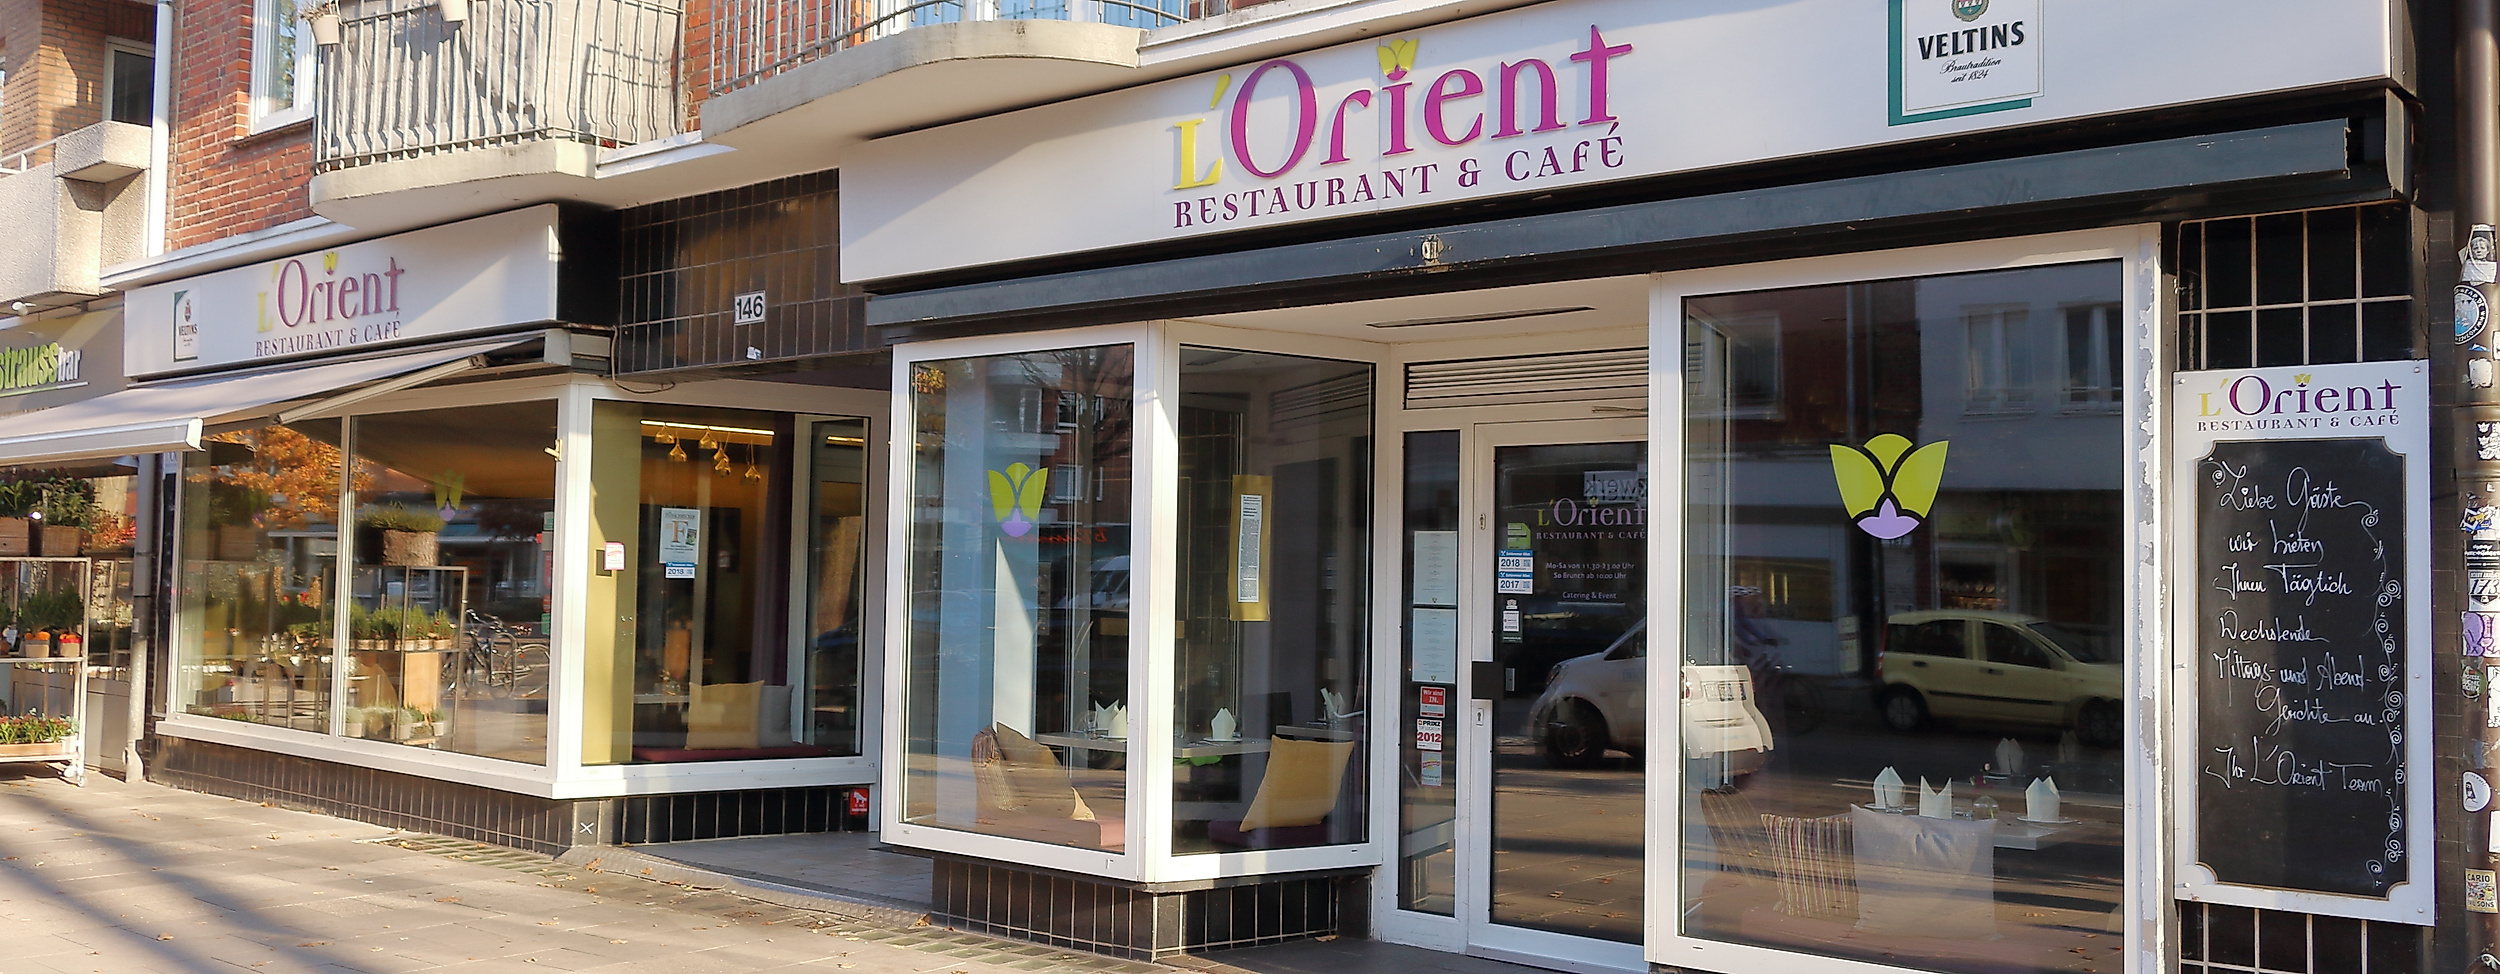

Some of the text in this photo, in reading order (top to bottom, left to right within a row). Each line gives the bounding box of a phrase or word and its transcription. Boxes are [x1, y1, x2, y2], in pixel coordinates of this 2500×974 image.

[1917, 20, 2025, 60] VELTINS
[1940, 57, 2001, 74] Brautradition
[1951, 69, 1989, 82] seit 1824
[1173, 24, 1634, 190] L'Orient
[1174, 122, 1624, 229] RESTAURANT & CAFÉ
[257, 256, 405, 332] L'Orient
[736, 295, 763, 320] 146
[255, 311, 401, 357] RESTAURANT & CAFÉ
[2198, 374, 2402, 416] L'Orient
[2197, 410, 2400, 432] RESTAURANT & CAFÉ
[1537, 497, 1646, 526] L'Orient
[2220, 461, 2347, 532] Liebe Gäste
[1537, 531, 1605, 540] RESTAURANT
[1618, 528, 1646, 539] CAFÉ
[2228, 520, 2324, 562] wir bieten
[1501, 558, 1520, 567] 2018
[1545, 562, 1567, 570] Mo-Sa
[1500, 580, 1519, 588] 2017
[1562, 591, 1590, 600] Catering
[2263, 563, 2352, 606] Täglich
[2255, 685, 2345, 736] Gerichte
[1417, 732, 1442, 742] 2012
[2328, 762, 2383, 798] Team
